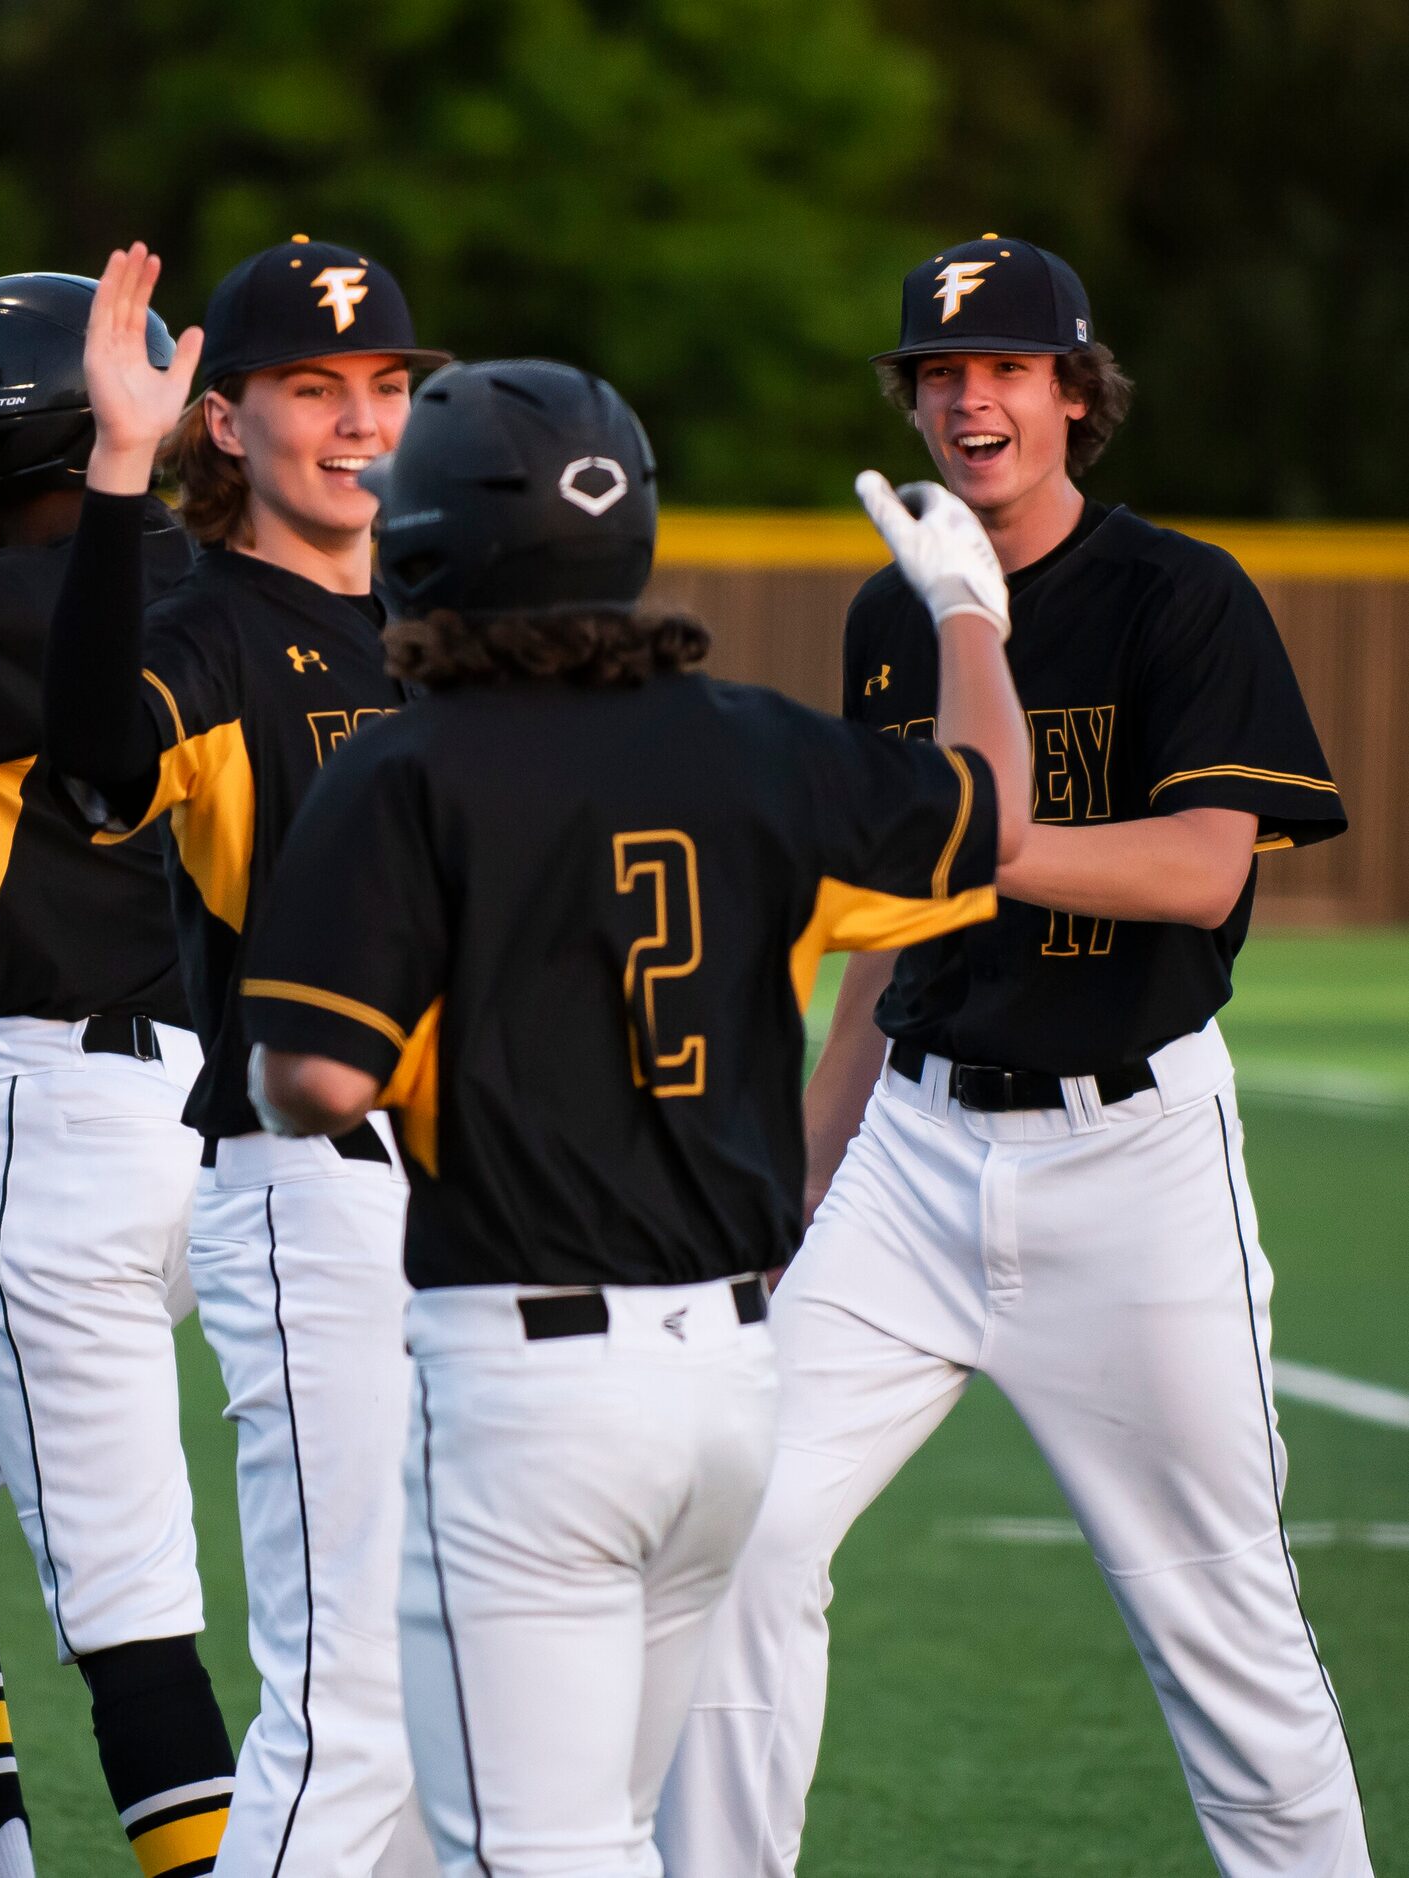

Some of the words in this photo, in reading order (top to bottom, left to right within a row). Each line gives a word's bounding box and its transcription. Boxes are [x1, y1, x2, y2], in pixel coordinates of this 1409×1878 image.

[310, 266, 369, 334] F
[933, 262, 996, 324] F
[612, 828, 706, 1098] 2
